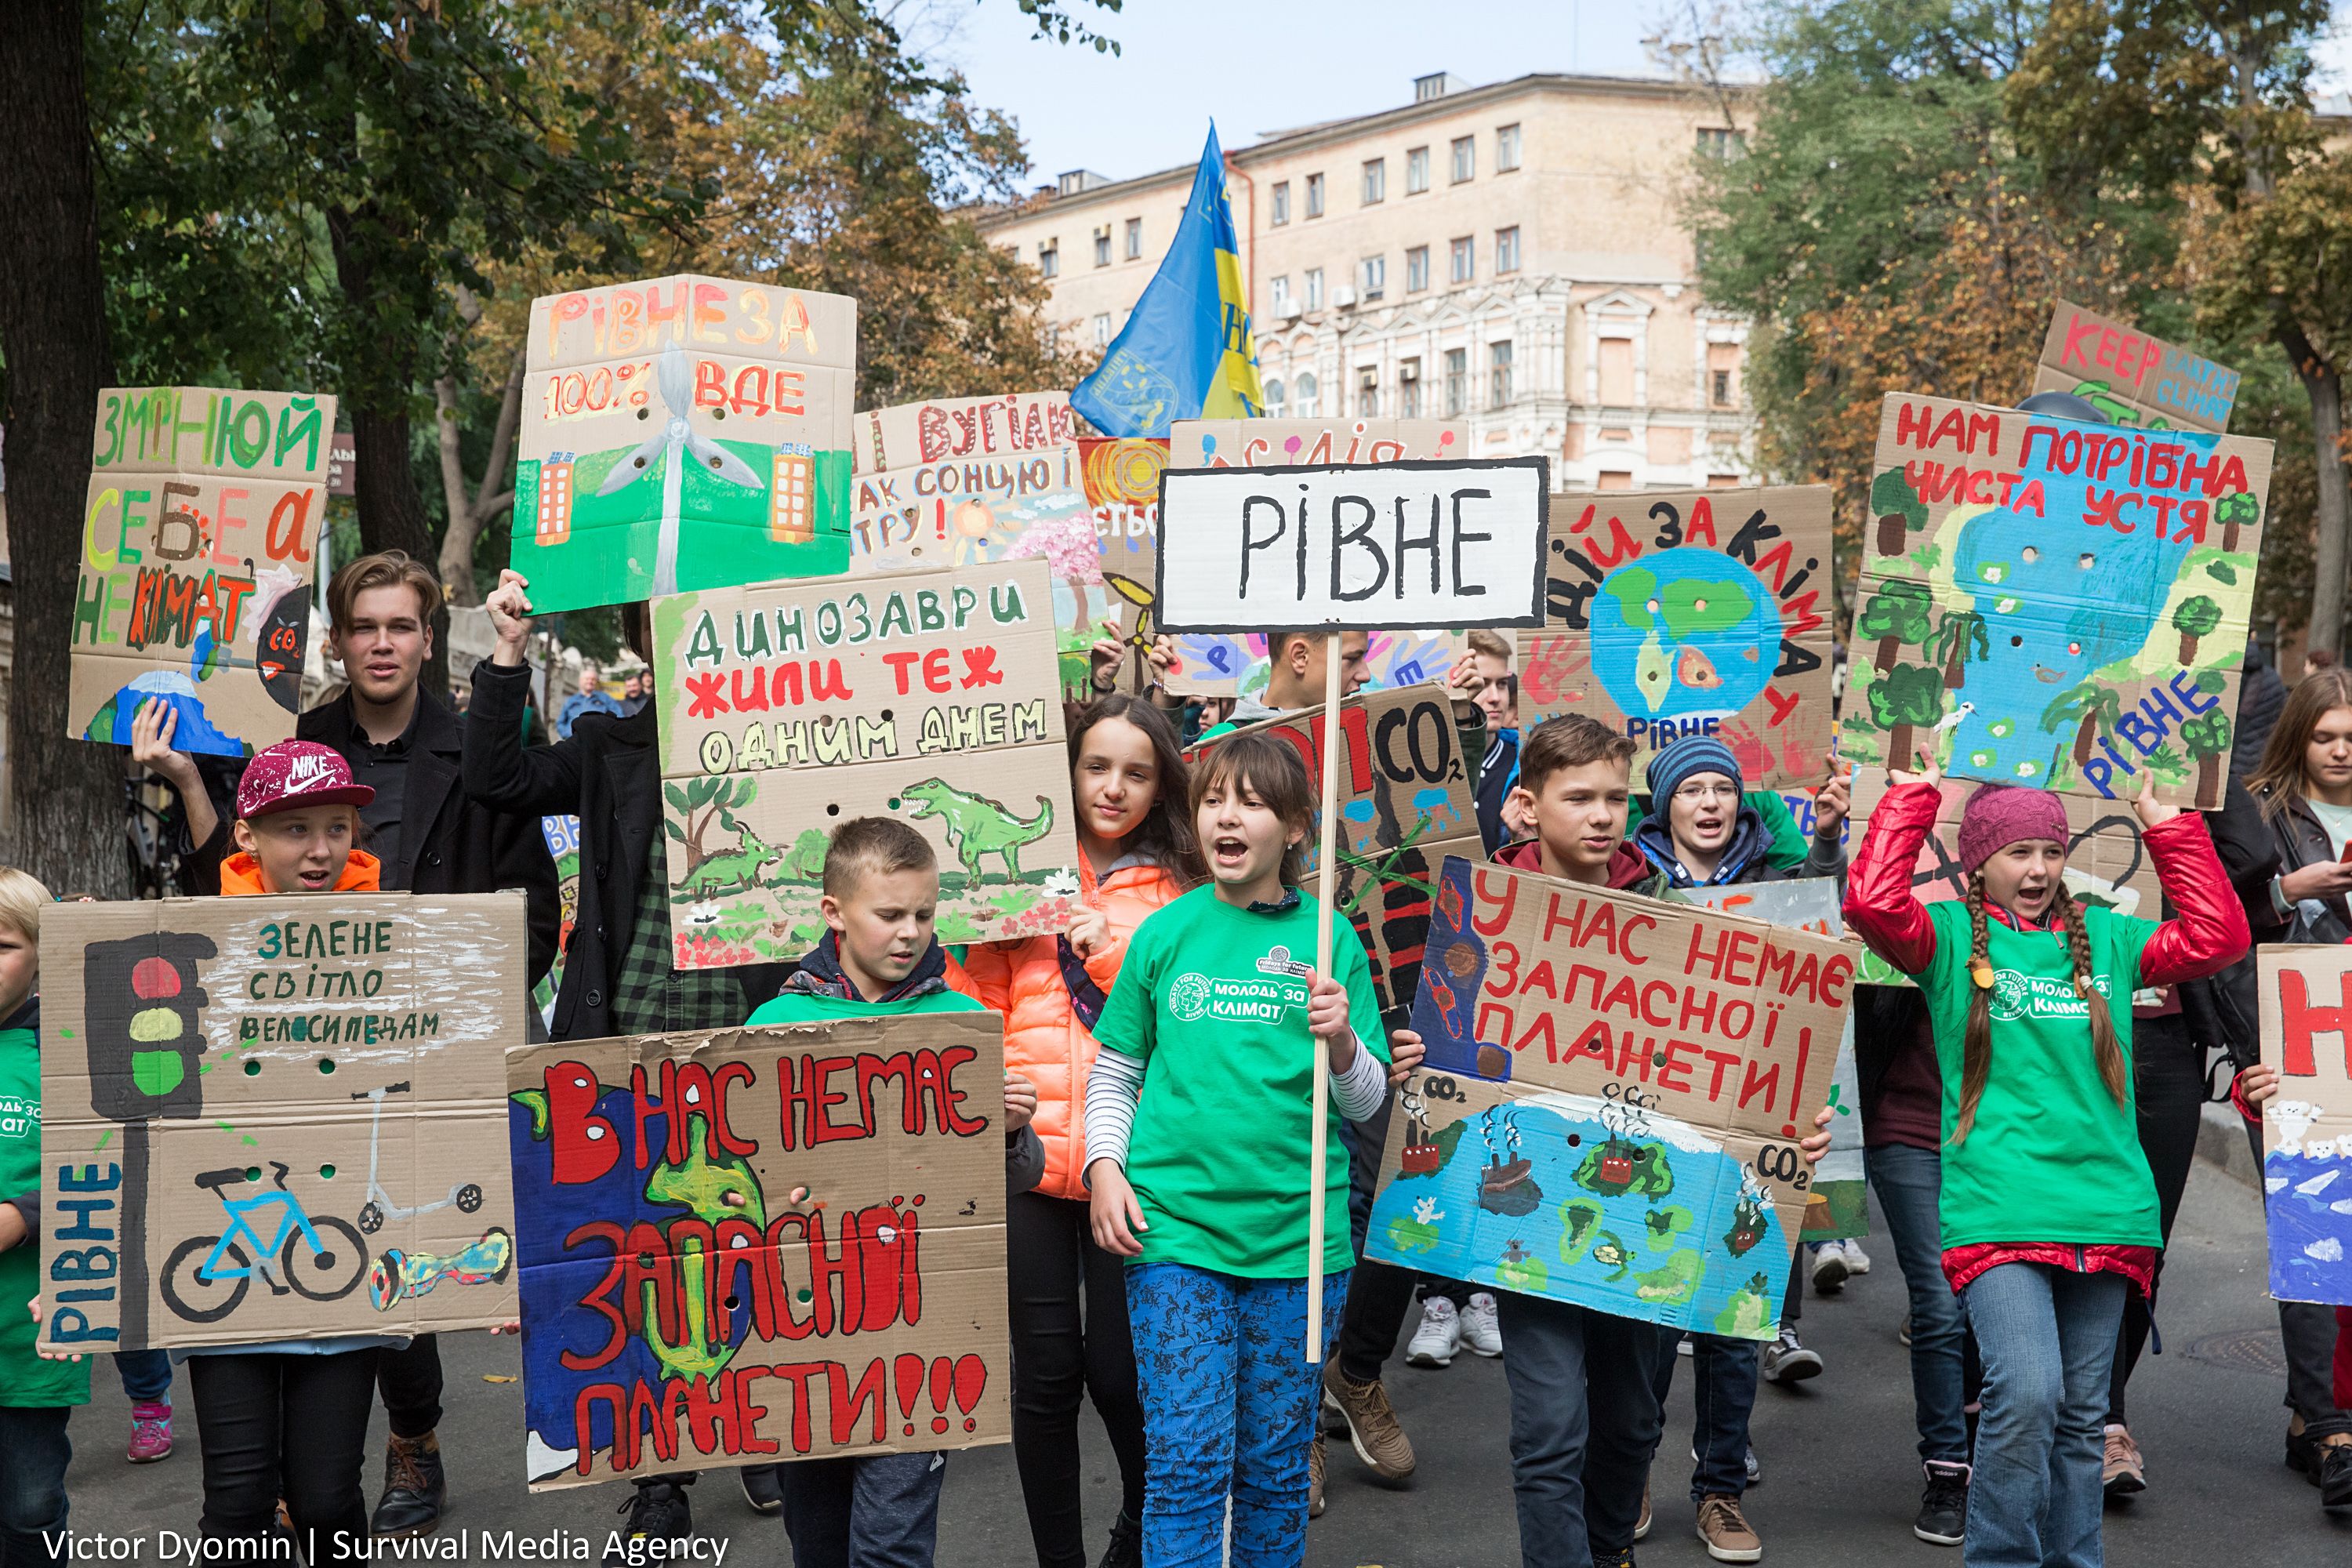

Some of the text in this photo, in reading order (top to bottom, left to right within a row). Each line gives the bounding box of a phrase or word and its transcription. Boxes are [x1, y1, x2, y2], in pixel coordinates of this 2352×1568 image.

[549, 282, 818, 361] РІВНЕ ЗА
[2060, 313, 2161, 387] KEEP
[544, 359, 806, 420] 100% ВДЕ
[95, 387, 322, 472] ЗМІНЮЙ
[1896, 401, 2000, 456] НАМ
[2019, 424, 2249, 499] ПОТРІБНА
[853, 477, 901, 513] АК
[914, 457, 1053, 499] СОНЦЮ
[1648, 496, 1717, 548] ЗА
[1904, 460, 2209, 545] ЧИСТА УСТЯ
[1239, 483, 1493, 602] РІВНЕ
[72, 573, 130, 645] НЕ
[683, 579, 1029, 671] ДИНОЗАВРИ
[685, 644, 1004, 720] ЖИЛИ ТЕЖ
[292, 755, 328, 780] NIKE
[699, 698, 1048, 775] ОДНИМ ДНЕМ
[2082, 669, 2219, 800] РІВНЕ
[257, 920, 394, 960] ЗЕЛЕНЕ
[1472, 869, 1854, 1008] У НАС НЕМАЄ
[249, 964, 383, 1000] СВІТЛО
[1171, 975, 1210, 1014] FRIDAYS FOR FUTURE
[1185, 1007, 1205, 1018] RIVNE
[1484, 942, 1786, 1047] ЗАПАСНОЇ
[2008, 974, 2029, 996] FUTURE
[2031, 980, 2077, 999] МОЛО
[239, 1012, 439, 1045] ВЕЛОСИПЕДАМ
[1475, 1003, 1812, 1138] ПЛАНЕТИ!
[544, 1045, 991, 1185] В НАС НЕМАЄ
[49, 1161, 122, 1343] РІВНЕ
[558, 1194, 926, 1371] ЗАПАСНОЇ
[575, 1352, 988, 1477] ПЛАНЕТИ!!!
